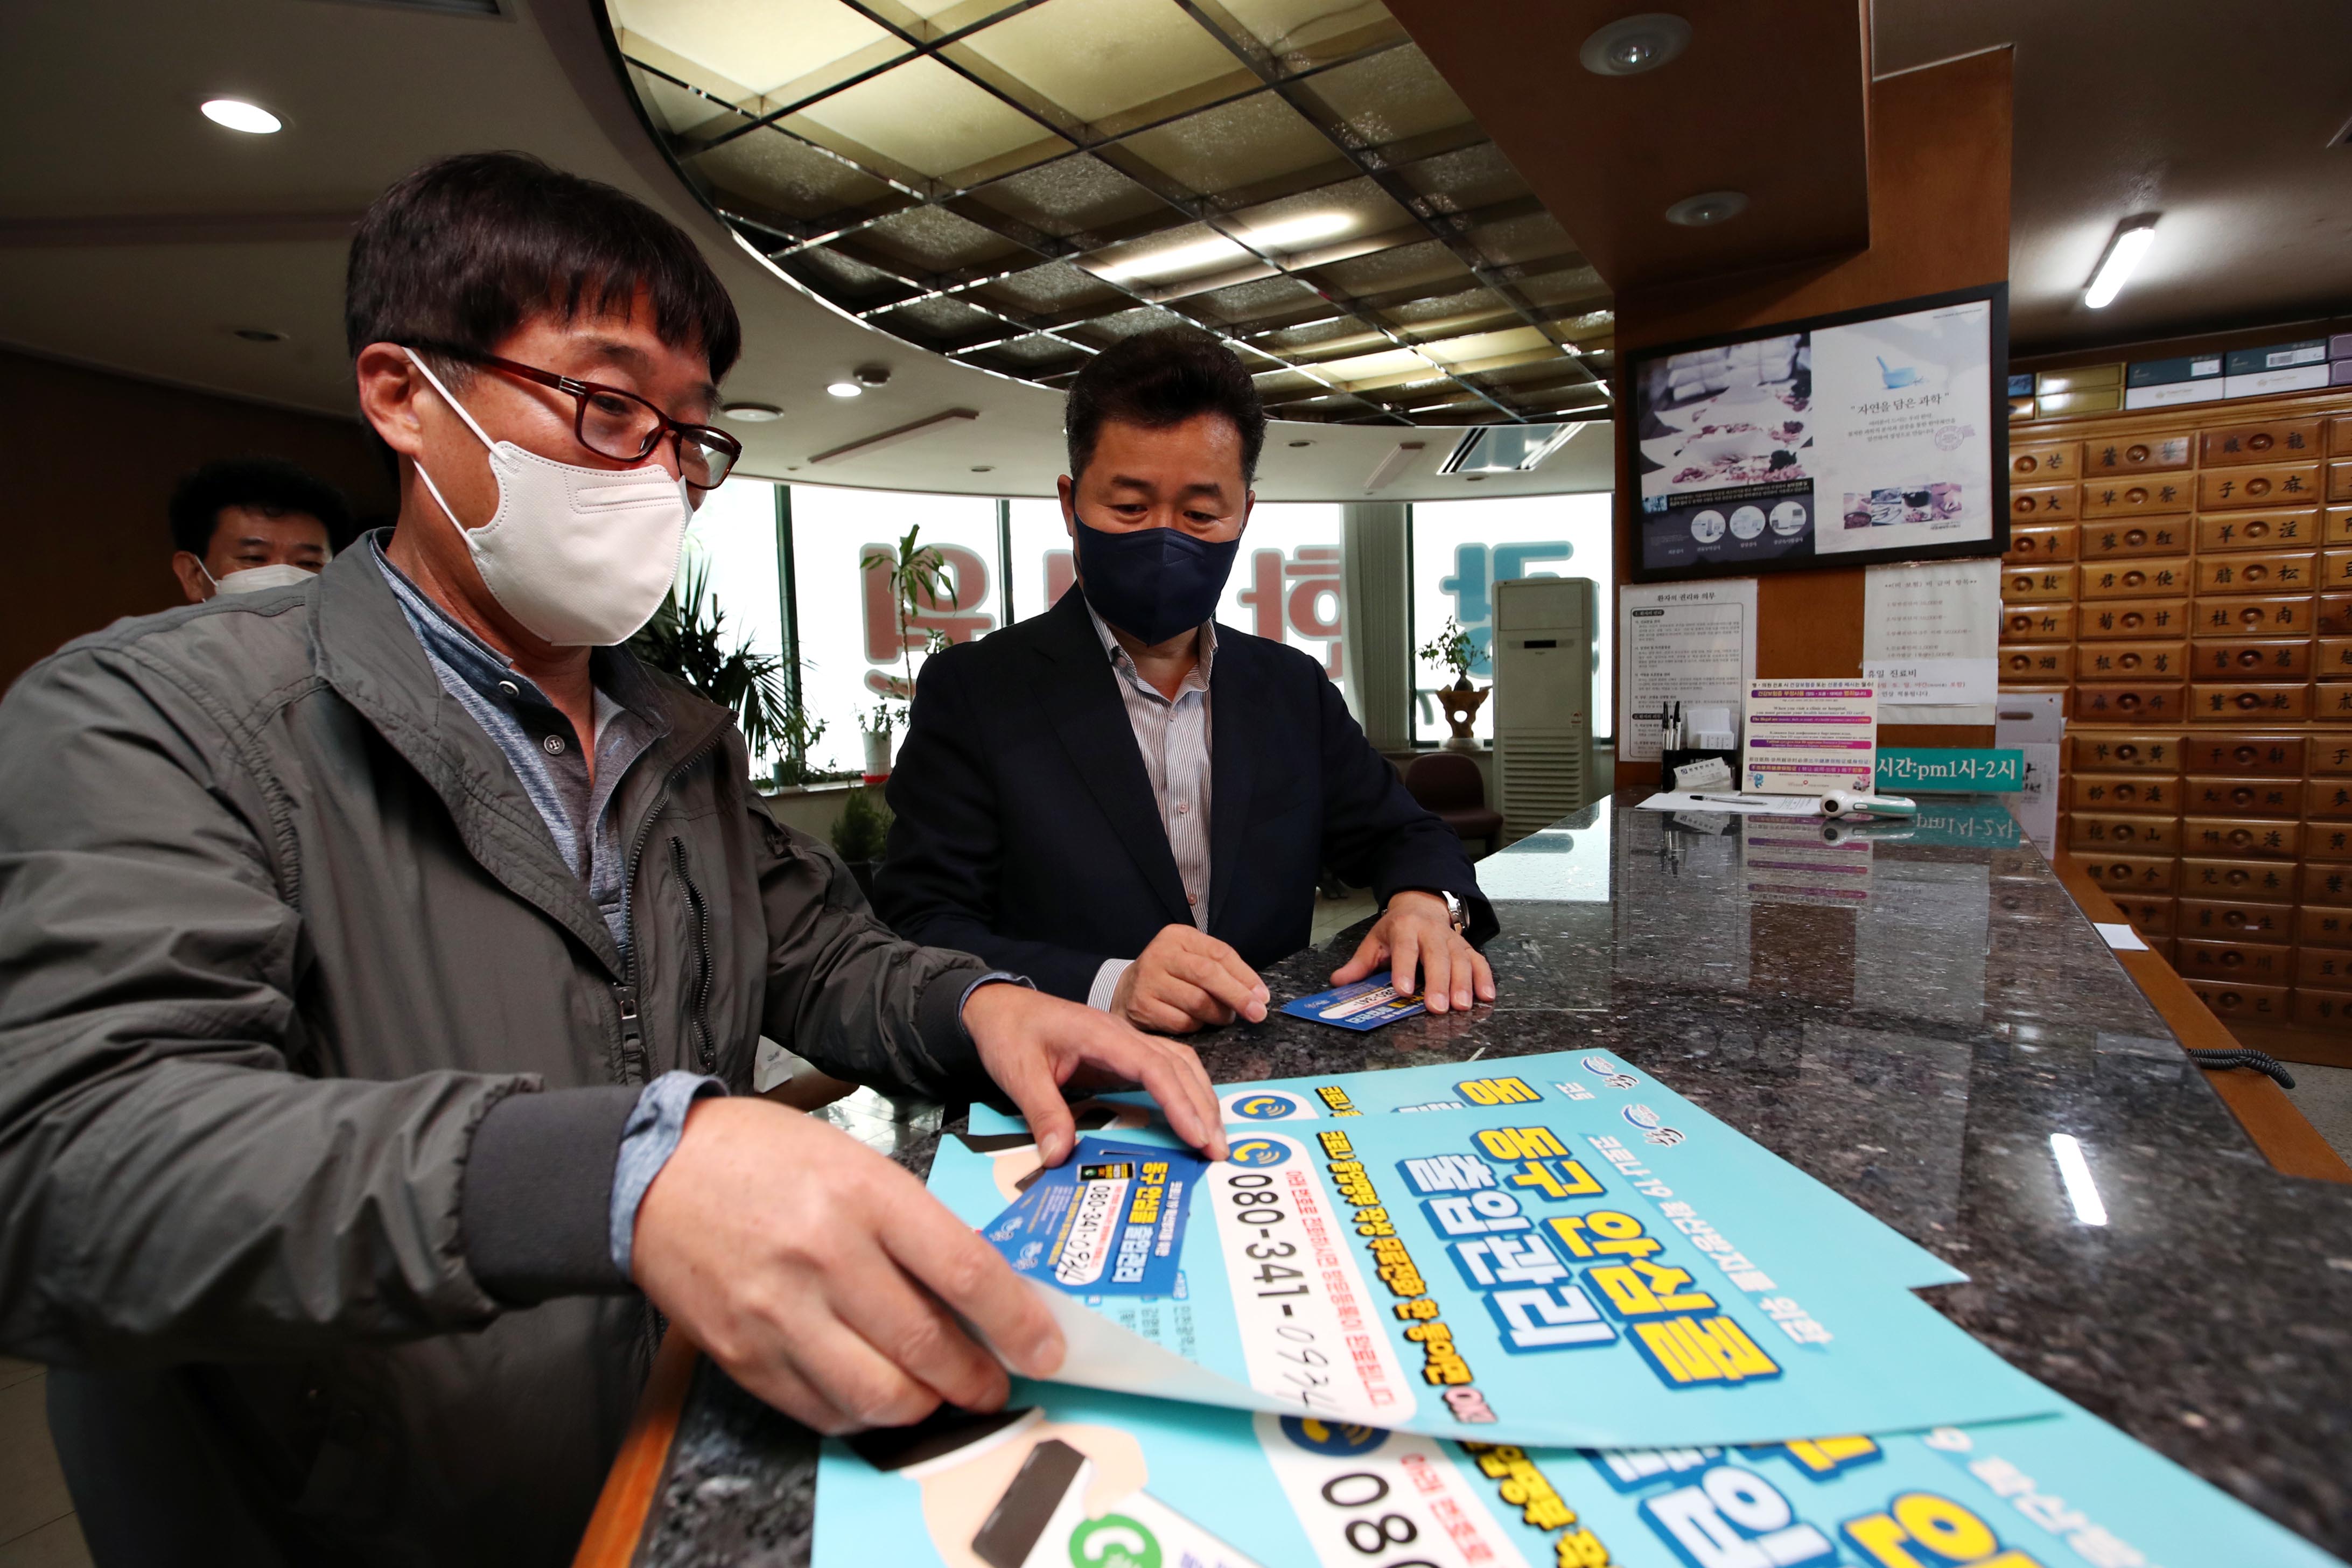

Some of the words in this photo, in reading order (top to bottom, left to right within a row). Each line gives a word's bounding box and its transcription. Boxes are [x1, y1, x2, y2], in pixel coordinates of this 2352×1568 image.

[1857, 401, 1891, 415] 자연을
[1893, 398, 1916, 411] 담은
[1919, 394, 1942, 406] 과학
[1869, 669, 1885, 678] 휴일
[1890, 669, 1917, 678] 진료비
[1316, 1130, 1356, 1161] 코로나
[1140, 1161, 1170, 1186] 동구
[1286, 1171, 1308, 1187] 아래
[1326, 1160, 1382, 1208] 출입명부
[1128, 1186, 1164, 1224] 안심콜
[1291, 1189, 1318, 1216] 번호로
[1350, 1206, 1396, 1237] 작성
[1399, 1155, 1619, 1350] 출입관리
[1474, 1126, 1606, 1198] 동구
[1543, 1212, 1779, 1387] 안심콜
[1588, 1135, 1651, 1177] 코로나
[1634, 1178, 1674, 1199] 19
[1660, 1200, 1777, 1292] 확산방지를
[1759, 1297, 1834, 1344] 위한
[1365, 1237, 1428, 1299] 무료전화
[1321, 1268, 1367, 1333] 방문등록이
[1392, 1298, 1440, 1322] 한
[1402, 1321, 1474, 1387] 통이면
